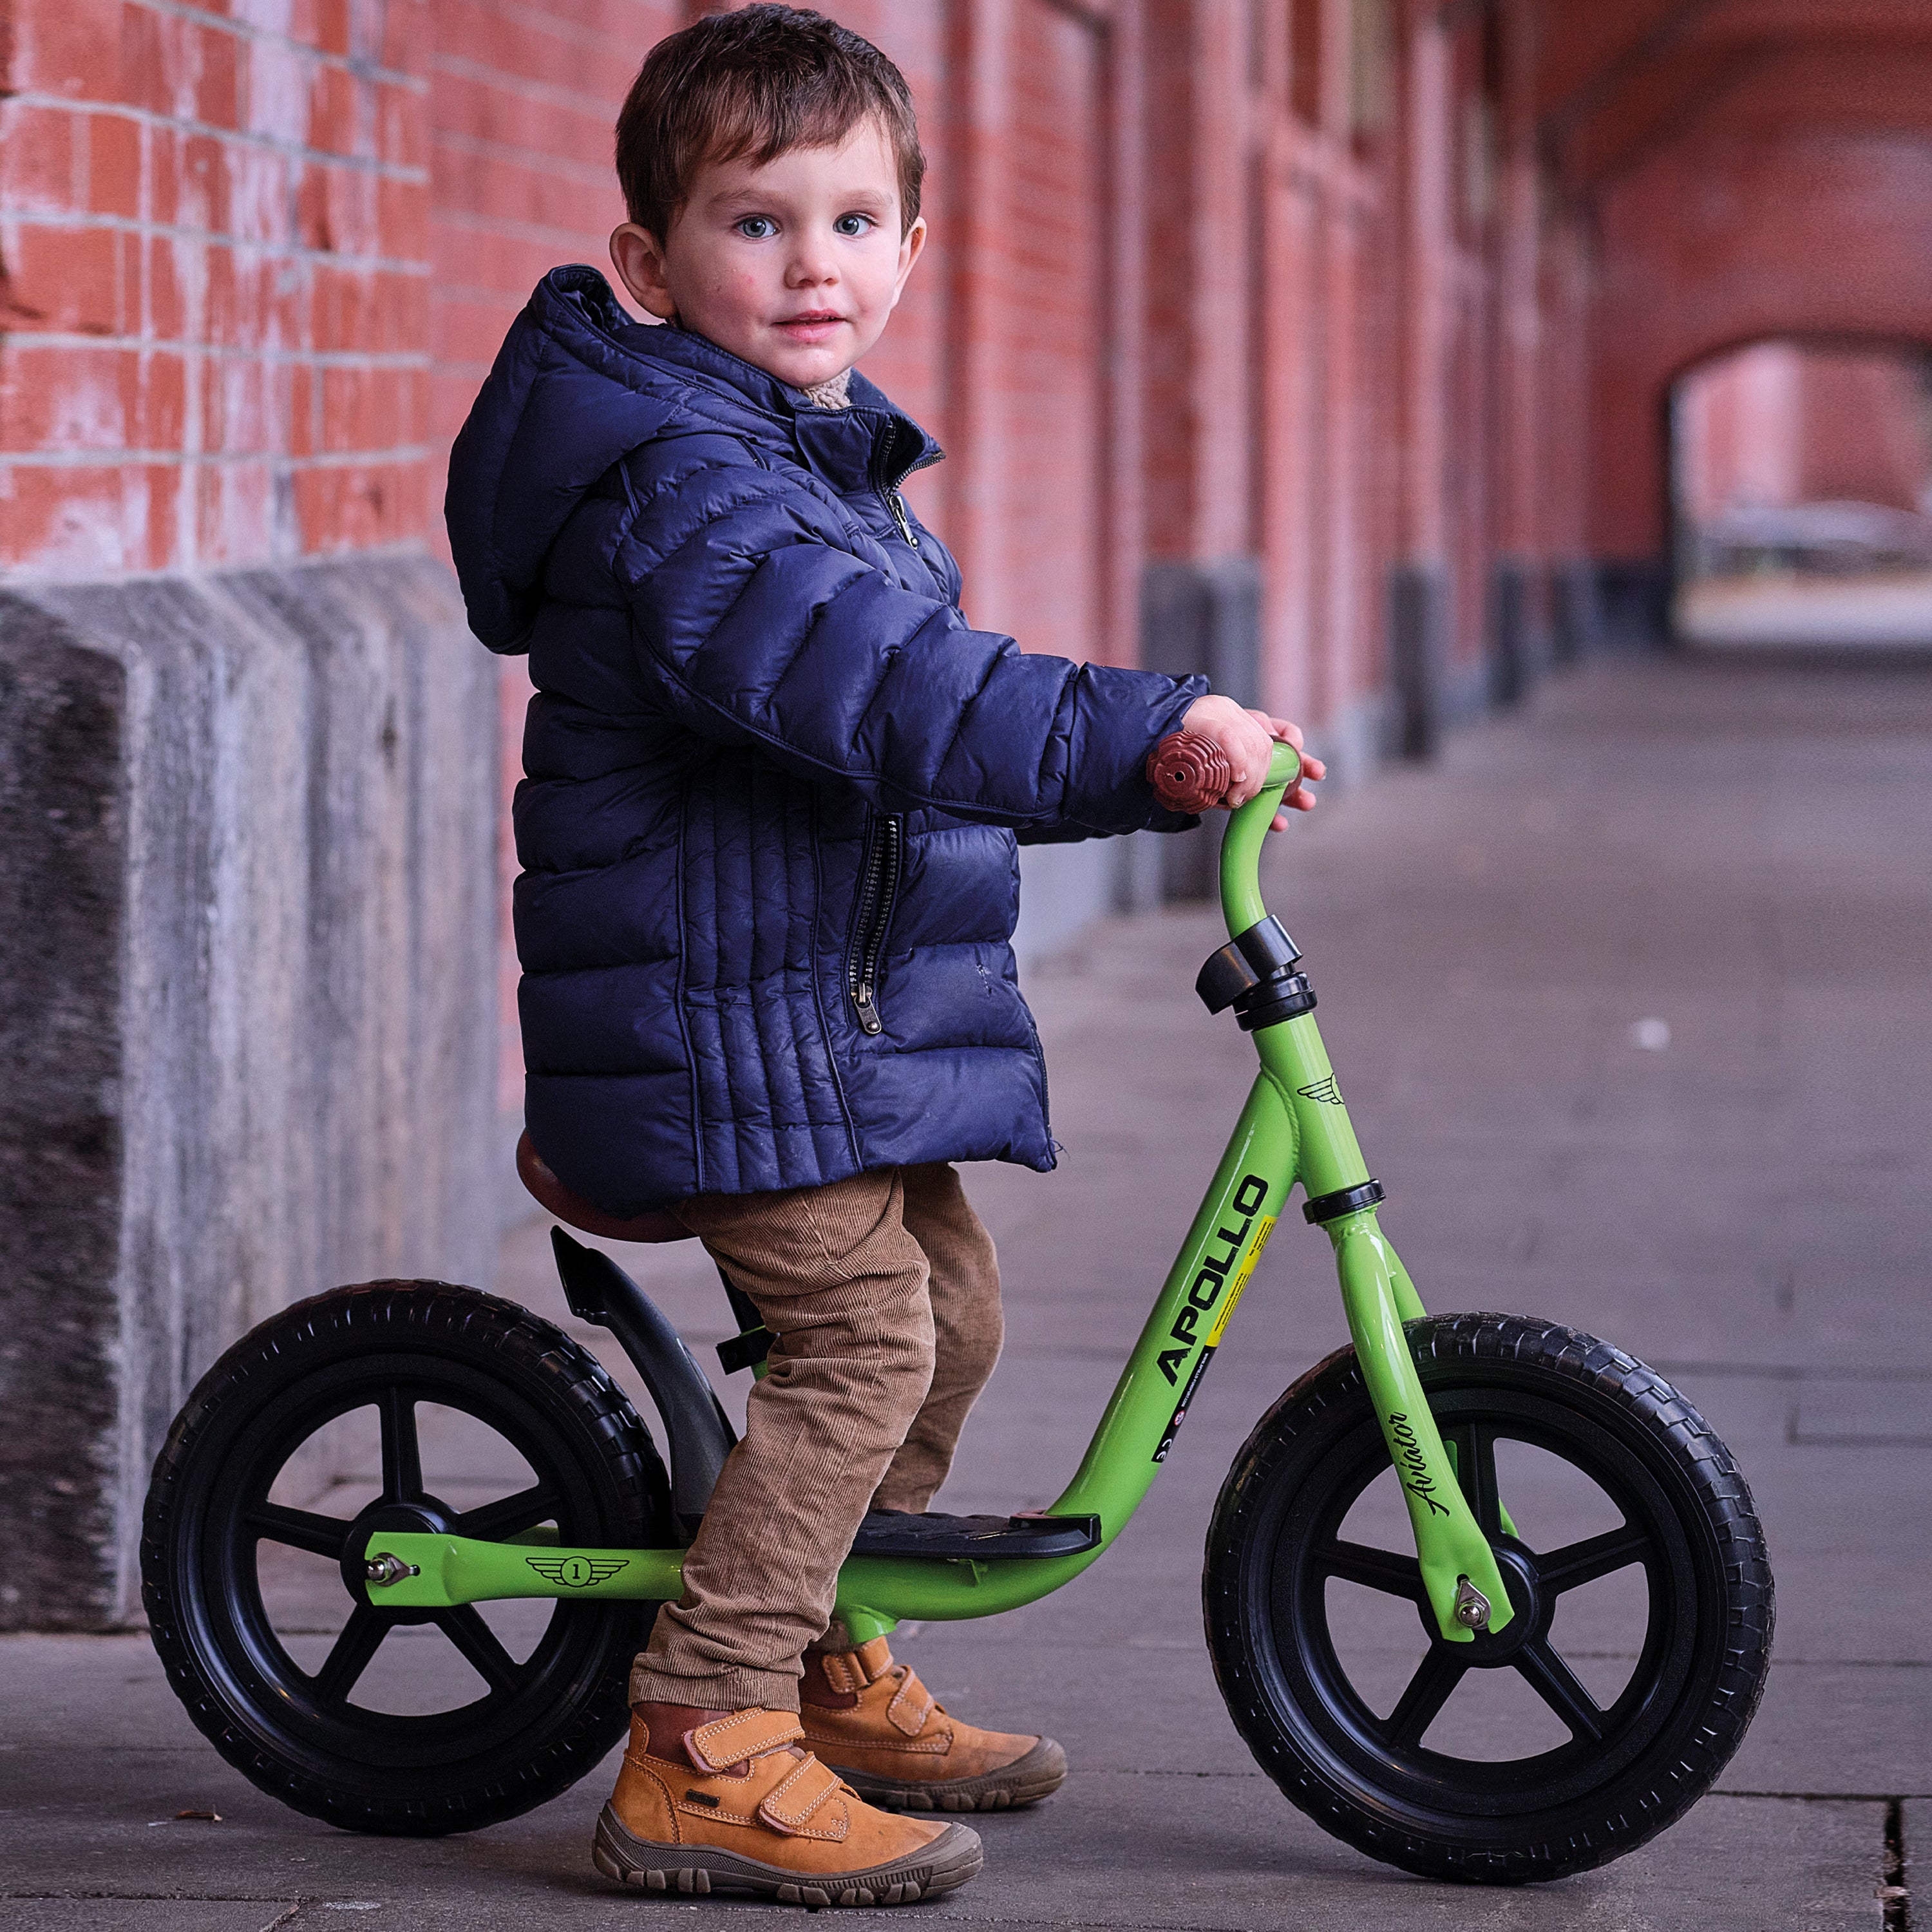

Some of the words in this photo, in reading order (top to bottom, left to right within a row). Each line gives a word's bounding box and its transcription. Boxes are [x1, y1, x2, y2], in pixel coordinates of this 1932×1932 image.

[1157, 1174, 1269, 1387] APOLLO
[1156, 1438, 1173, 1460] CE
[1388, 1411, 1450, 1517] Aviator
[572, 1564, 580, 1579] 1
